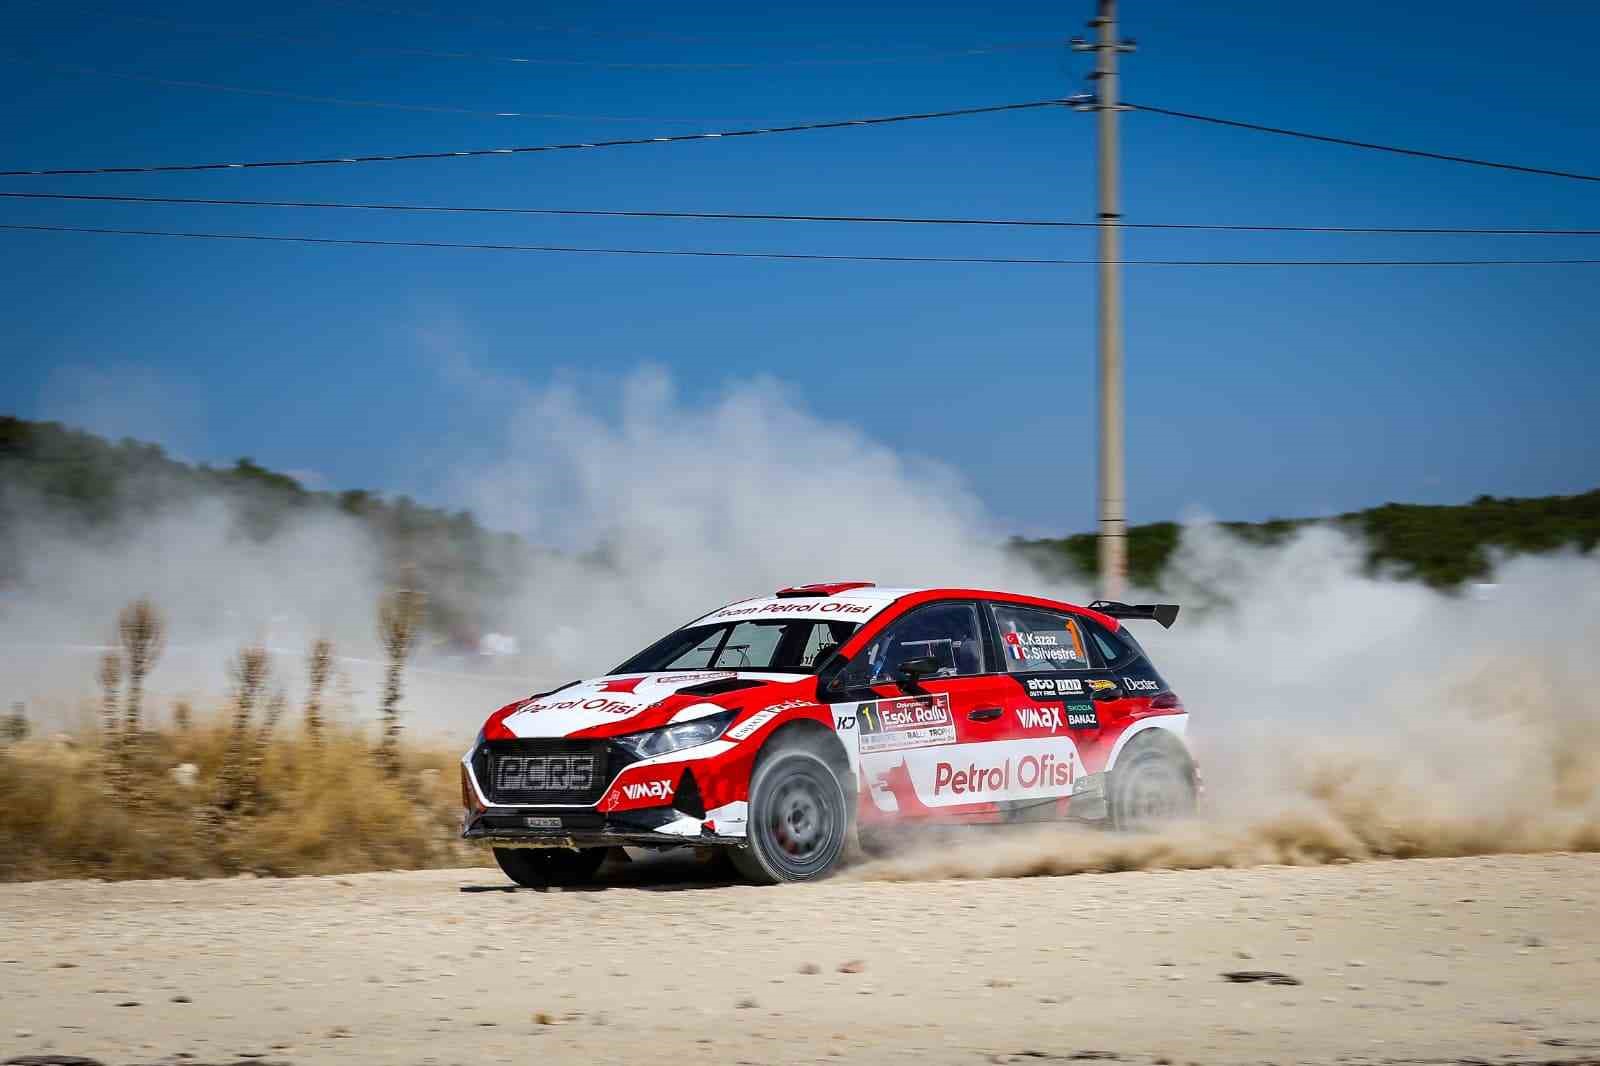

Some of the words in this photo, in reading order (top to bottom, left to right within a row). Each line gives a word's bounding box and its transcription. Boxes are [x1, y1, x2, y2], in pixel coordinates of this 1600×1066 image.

[759, 603, 818, 614] Petrol
[820, 603, 872, 614] Ofisi
[1017, 631, 1058, 646] K.Kazaz
[1024, 647, 1076, 660] C.Silvestre
[1122, 677, 1159, 690] Dexter
[583, 699, 642, 714] Ofisi
[863, 707, 875, 730] 1
[882, 707, 912, 725] Esok
[915, 704, 948, 724] Rally
[1068, 714, 1097, 725] BANAZ
[935, 758, 1009, 795] Petrol
[1017, 752, 1075, 789] Ofisi
